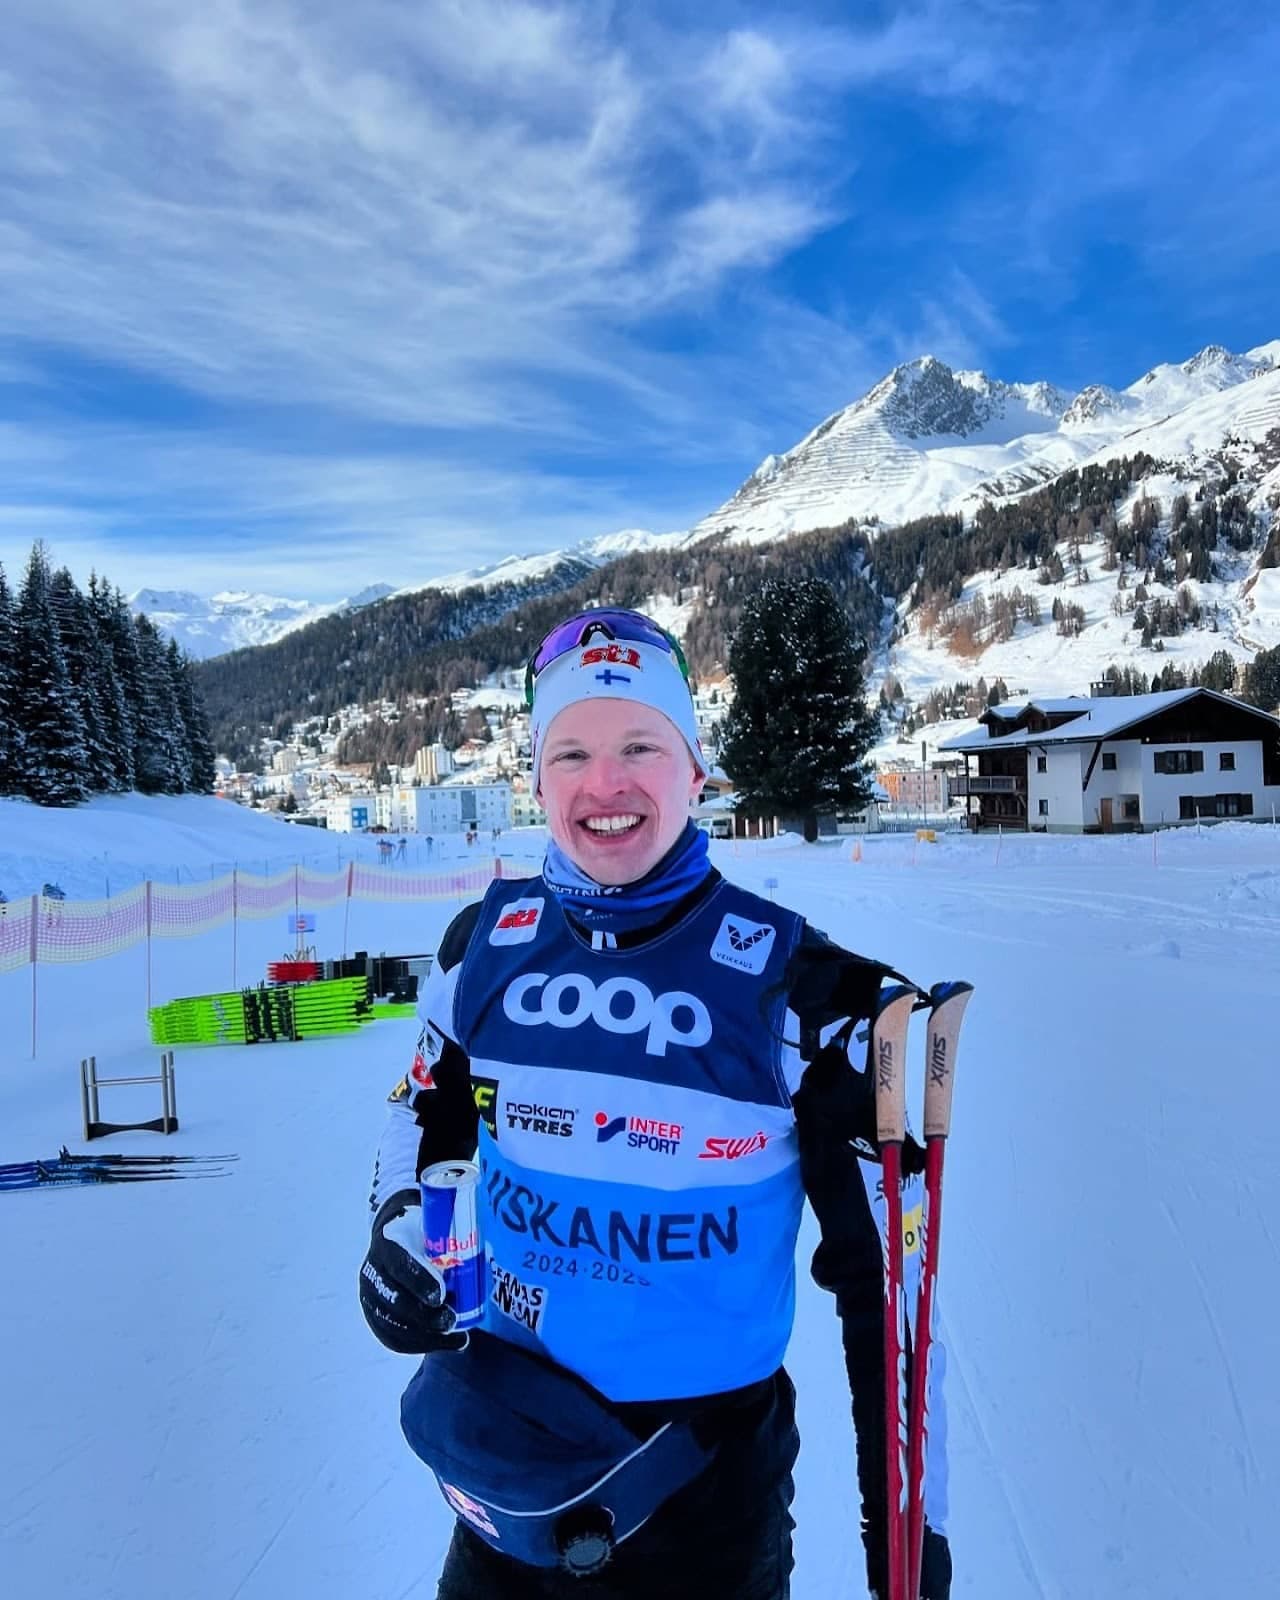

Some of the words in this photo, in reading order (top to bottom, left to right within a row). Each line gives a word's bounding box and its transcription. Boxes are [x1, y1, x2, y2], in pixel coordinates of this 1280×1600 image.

[716, 951, 753, 969] VEIKKAUS
[502, 972, 713, 1057] coop
[506, 1102, 575, 1120] nokian
[506, 1115, 573, 1137] TYRES
[629, 1116, 682, 1139] INTER
[627, 1133, 681, 1155] SPORT
[447, 1231, 478, 1253] Bull
